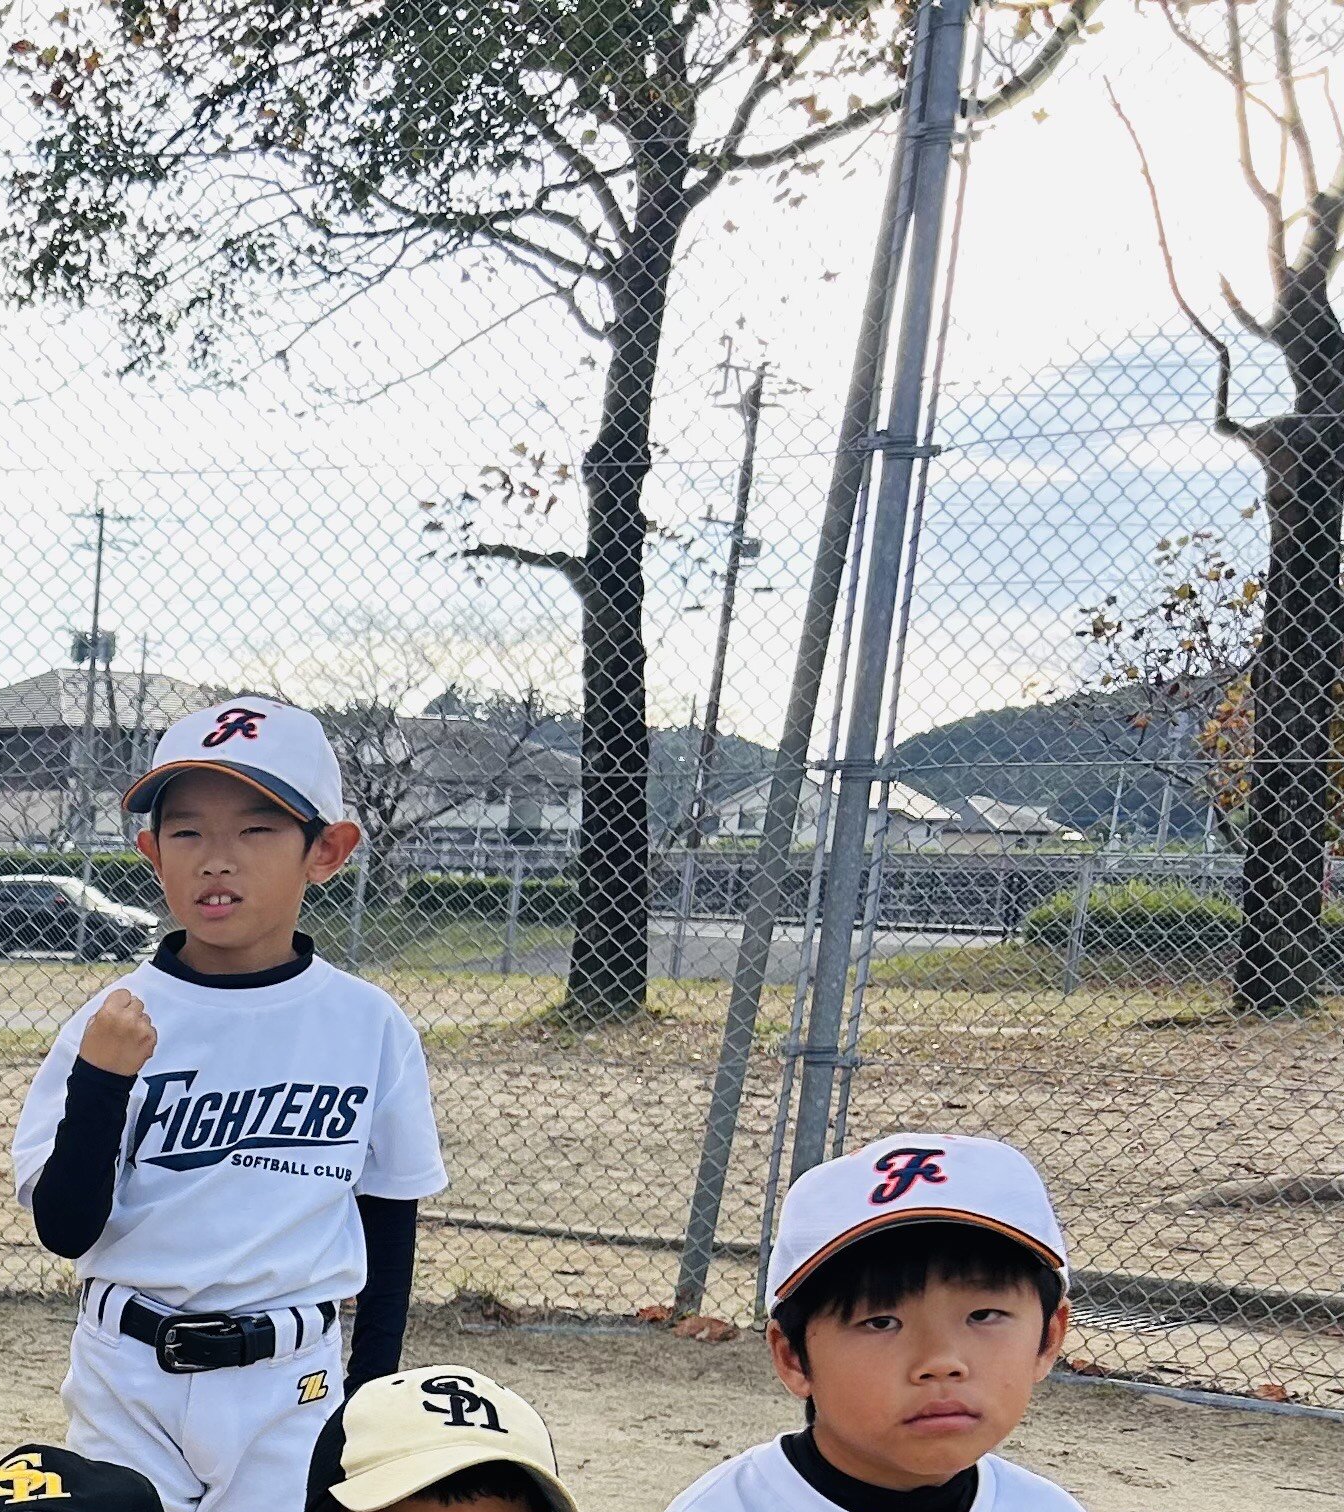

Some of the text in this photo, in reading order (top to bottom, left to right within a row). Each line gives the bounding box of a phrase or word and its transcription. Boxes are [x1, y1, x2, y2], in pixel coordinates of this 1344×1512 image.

[128, 1069, 369, 1169] FIGHTERS
[230, 1153, 353, 1183] SOFTBALL CLUB
